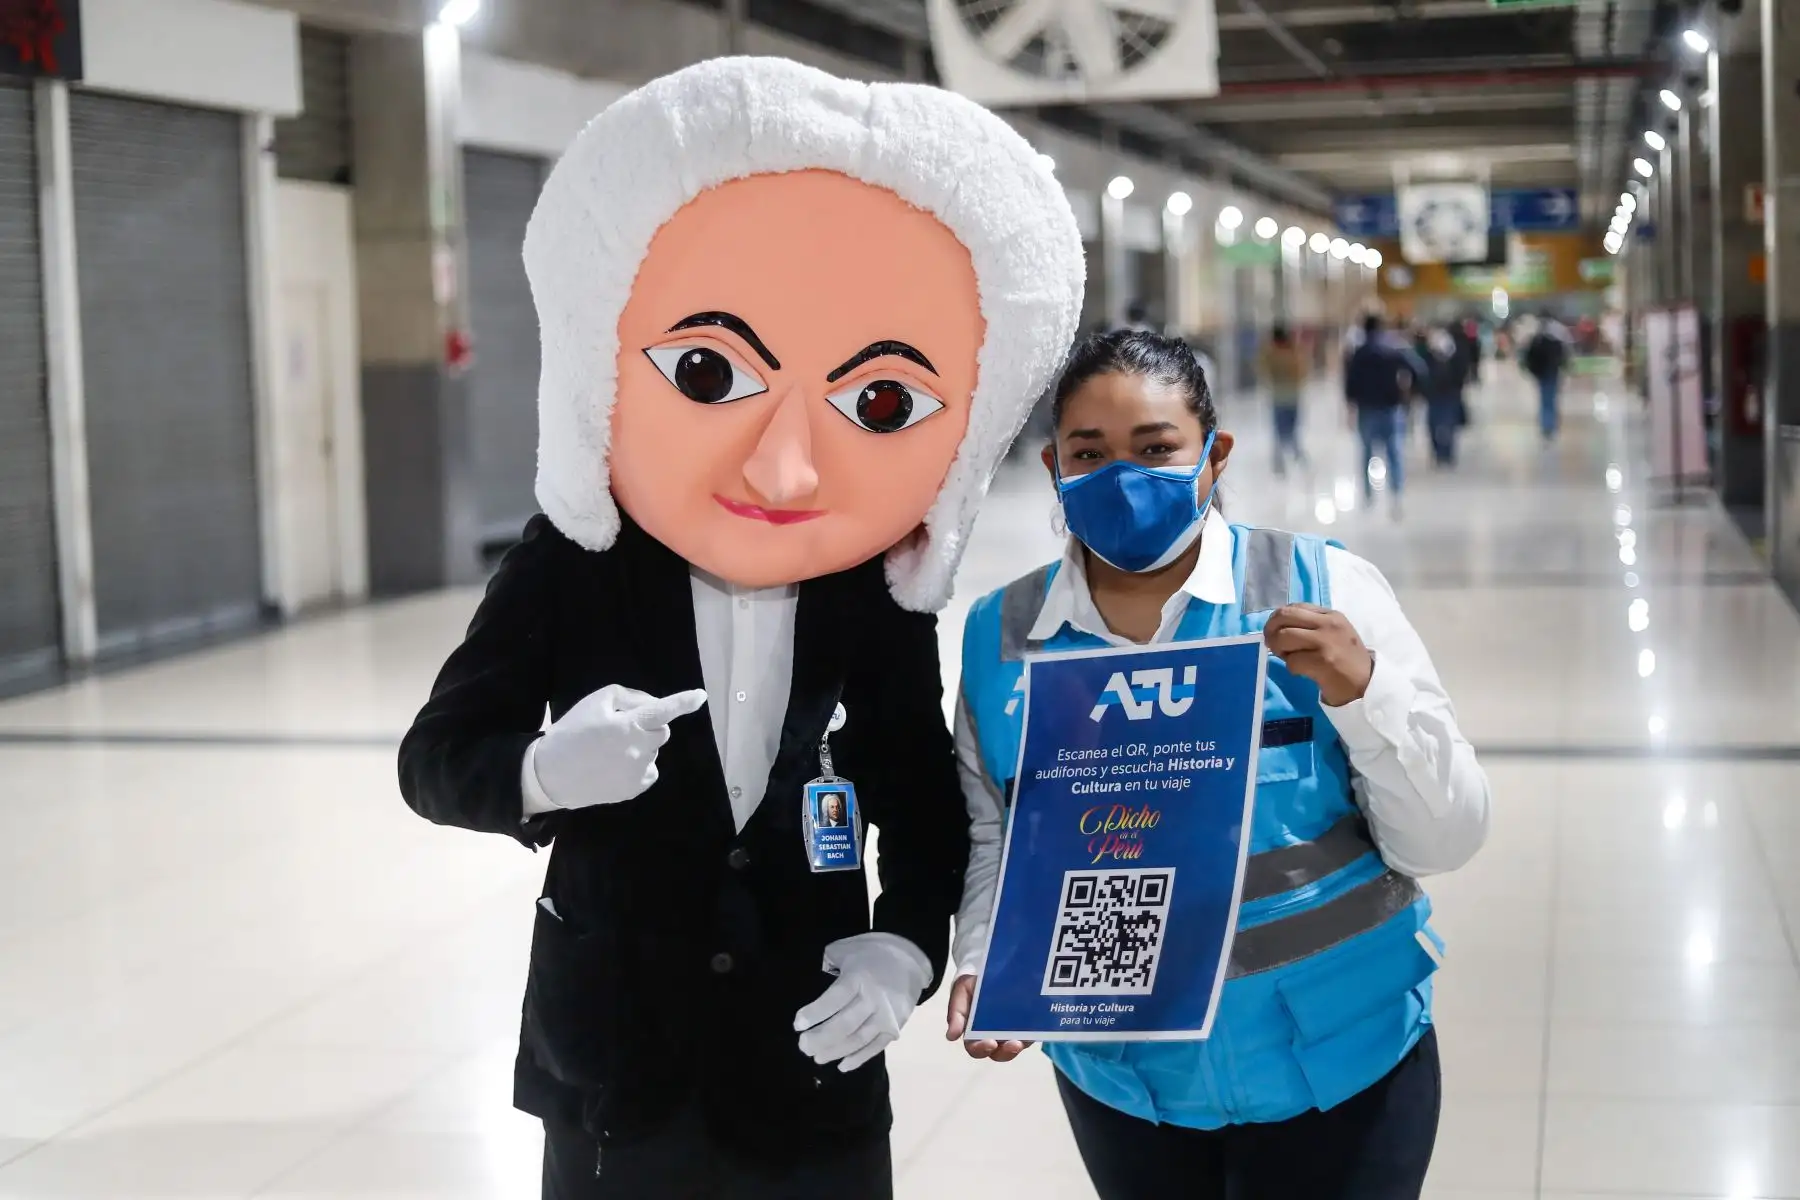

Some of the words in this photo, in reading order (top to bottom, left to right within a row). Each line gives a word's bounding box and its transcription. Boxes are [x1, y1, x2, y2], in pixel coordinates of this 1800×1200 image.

[1089, 665, 1197, 723] ATU
[1057, 748, 1108, 761] Escanea
[1111, 744, 1122, 758] el
[1126, 743, 1149, 757] QR,
[1153, 741, 1192, 757] ponte
[1195, 739, 1216, 752] tus
[1035, 765, 1097, 780] audífonos
[1099, 766, 1109, 779] y
[1111, 760, 1164, 775] escucha
[1167, 755, 1223, 771] Historia
[1225, 756, 1236, 771] y
[1071, 780, 1122, 795] Cultura
[1124, 780, 1141, 792] en
[1144, 778, 1158, 791] tu
[1161, 776, 1191, 791] viaje
[1080, 803, 1160, 834] Dicho
[1050, 1002, 1088, 1012] Historia
[1089, 1004, 1096, 1014] y
[1097, 1002, 1135, 1012] Cultura
[1060, 1017, 1080, 1026] para
[1083, 1016, 1092, 1024] tu
[1094, 1016, 1115, 1026] viaje
